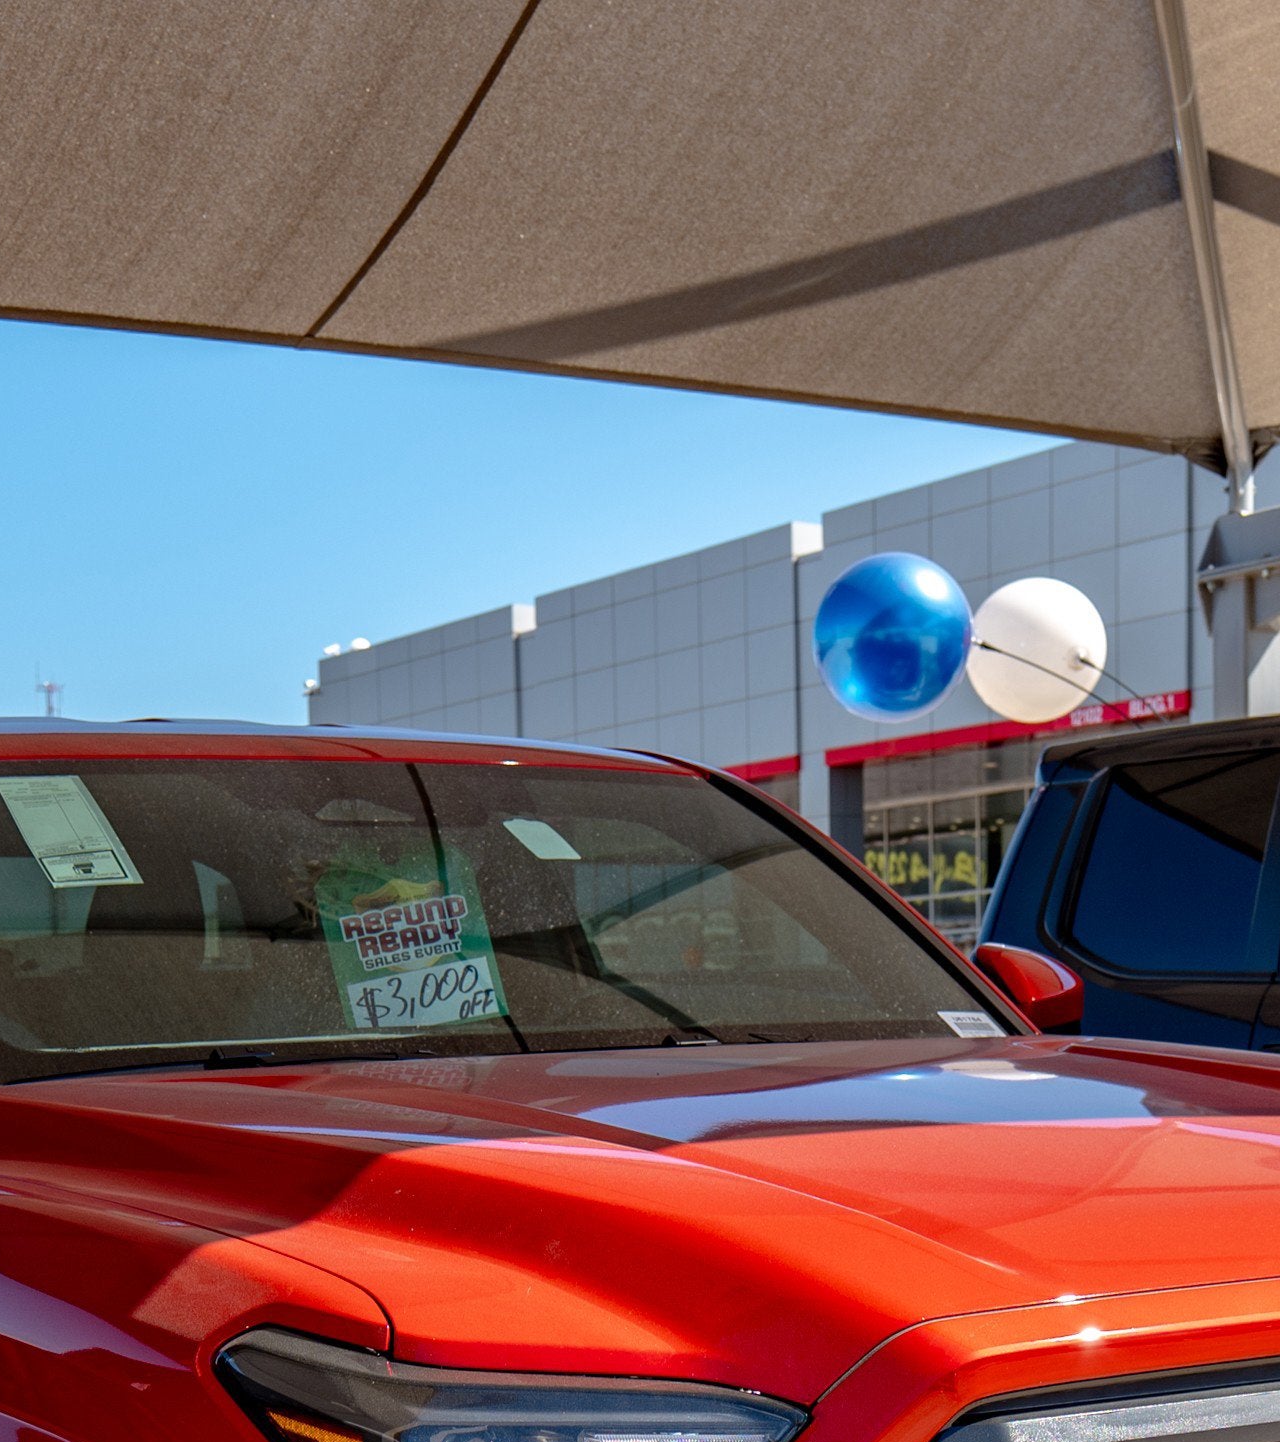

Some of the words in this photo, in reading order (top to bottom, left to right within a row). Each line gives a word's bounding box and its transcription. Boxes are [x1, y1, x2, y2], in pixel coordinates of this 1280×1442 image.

[340, 896, 468, 941] REFUND
[357, 919, 461, 959] READY
[364, 951, 411, 970] SALES
[415, 941, 461, 959] EVENT
[356, 965, 479, 1028] $3,000
[459, 988, 494, 1020] OFF
